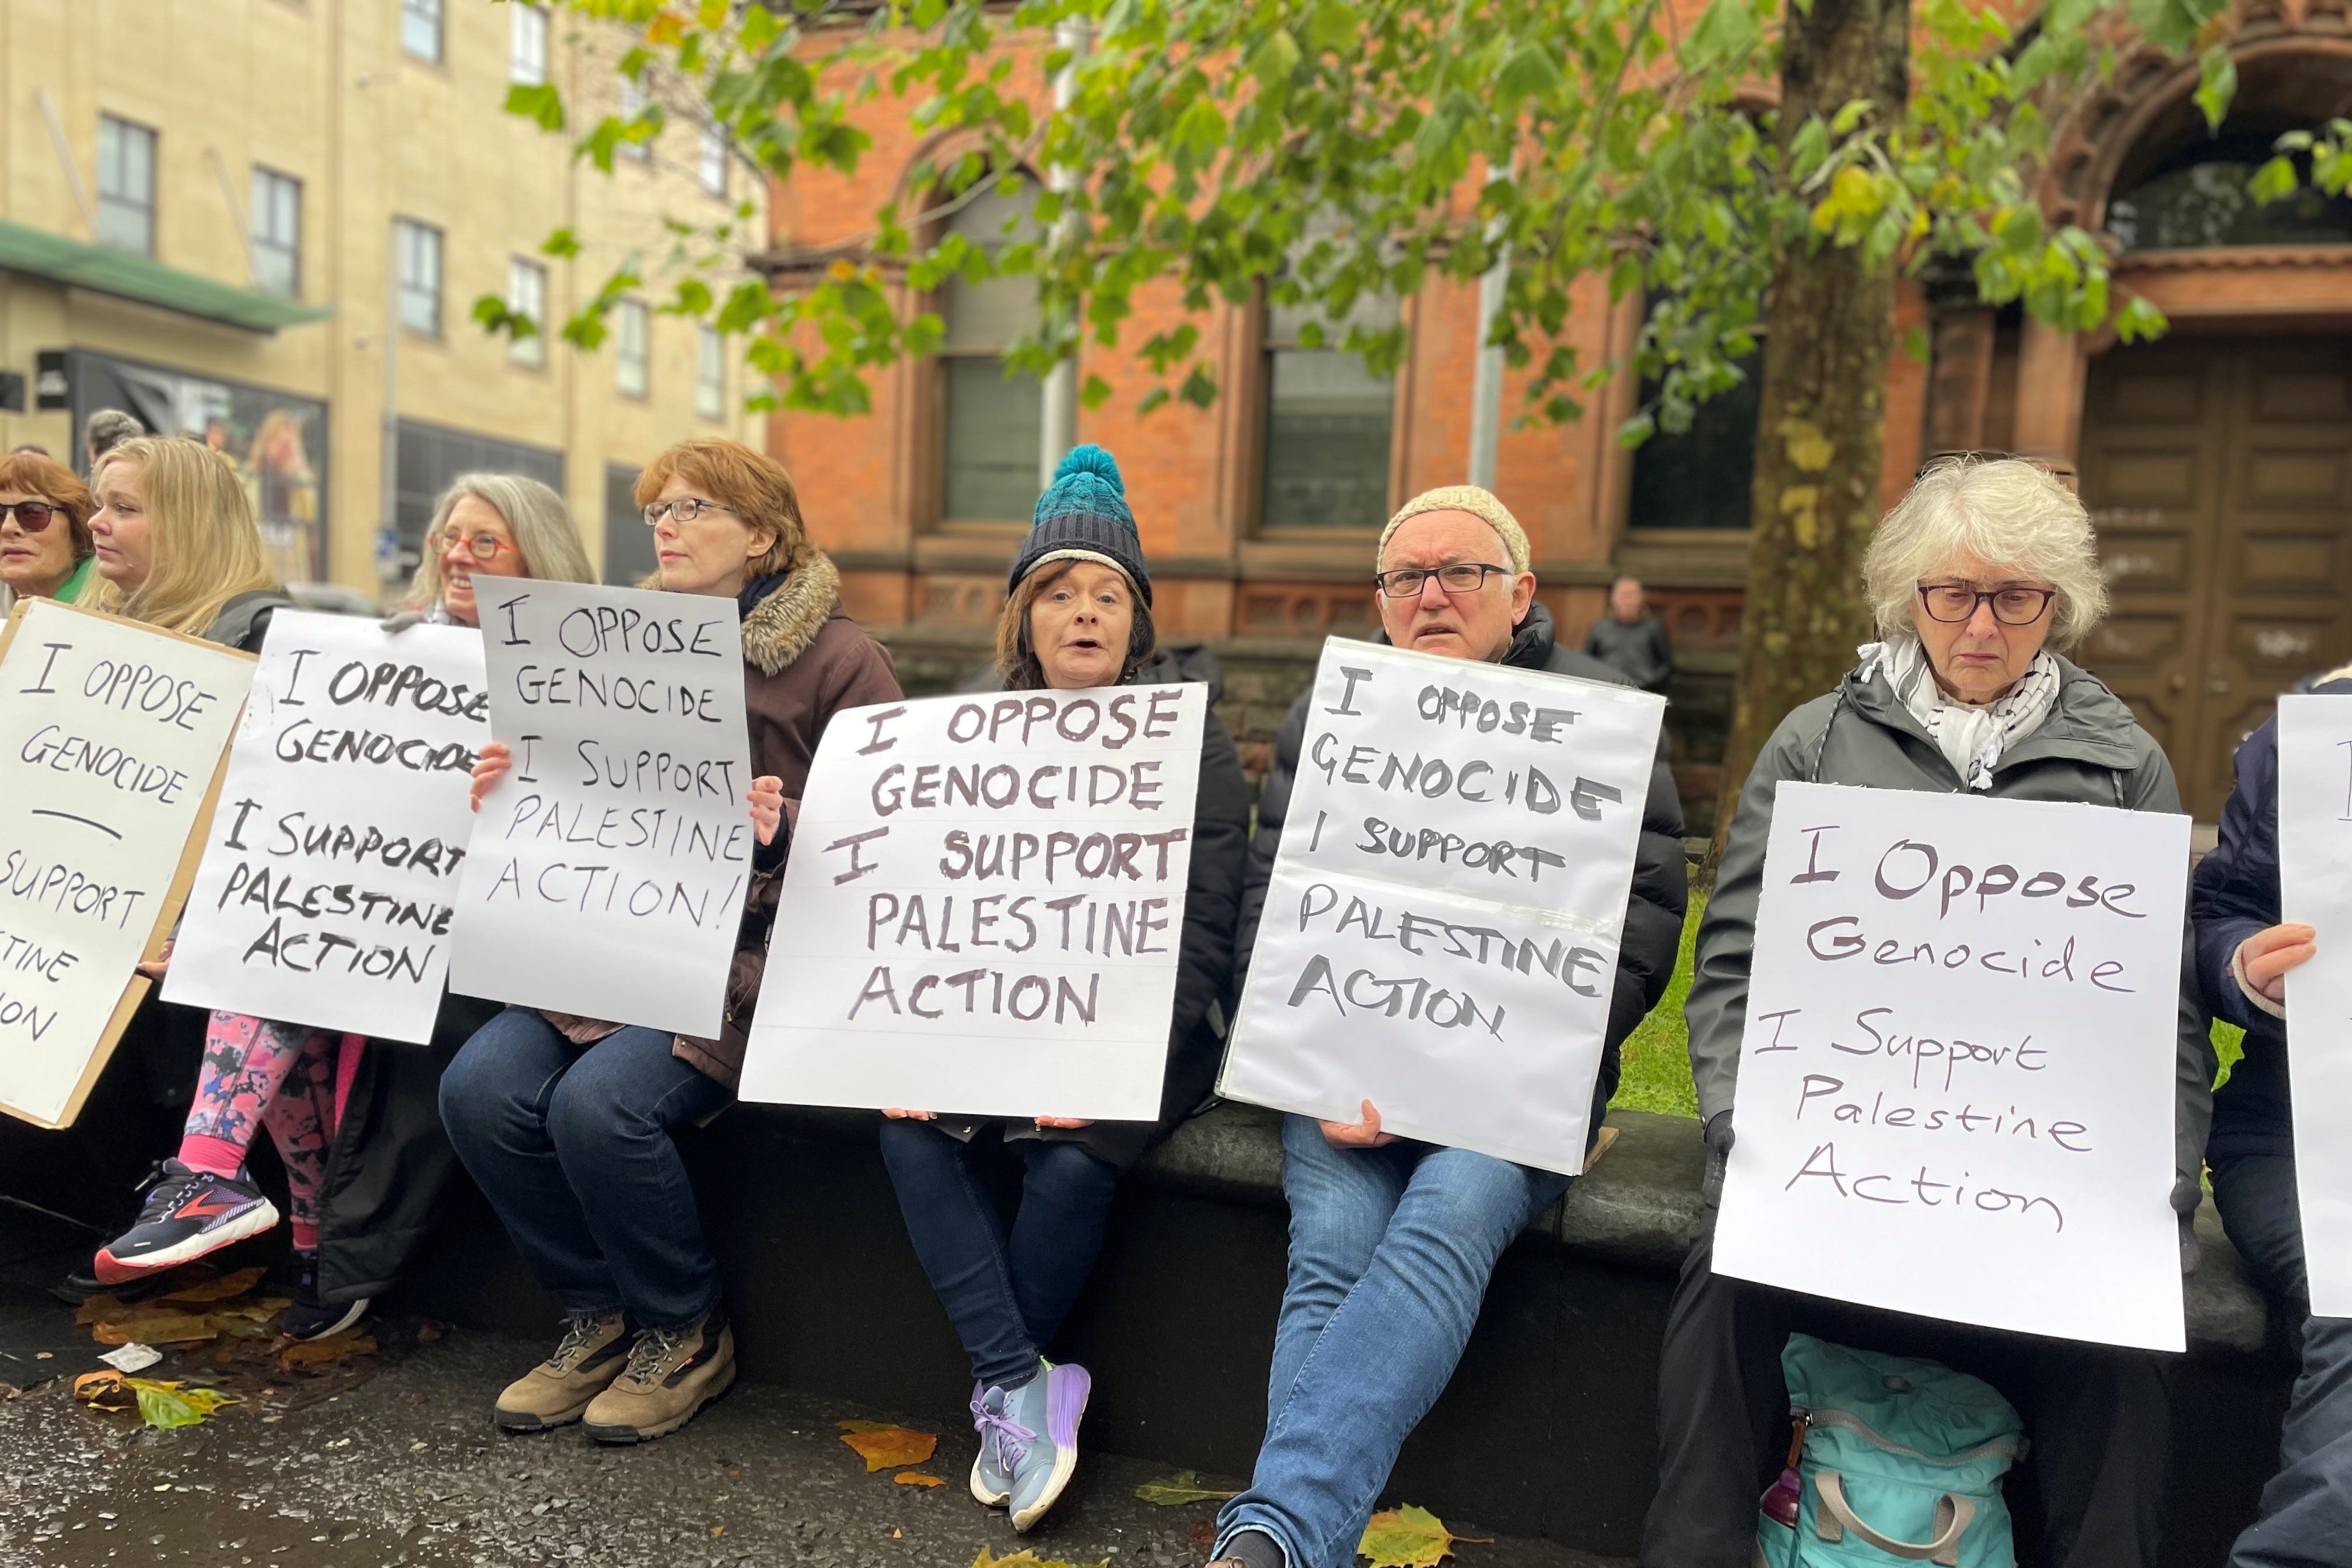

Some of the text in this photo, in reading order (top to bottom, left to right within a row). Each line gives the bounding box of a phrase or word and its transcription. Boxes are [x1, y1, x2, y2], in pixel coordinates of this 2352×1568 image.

[498, 593, 724, 659] I OPPOSE
[19, 642, 218, 732] I OPPOSE
[278, 649, 489, 723] I OPPOSE
[516, 664, 722, 723] GENOCIDE
[855, 688, 1184, 757] I OPPOSE
[1324, 666, 1583, 744] I OPPOSE
[20, 724, 188, 804] GENOCIDE
[517, 734, 735, 807] I SUPPORT
[871, 761, 1166, 817] GENOCIDE
[1311, 732, 1622, 821] GENOCIDE
[223, 797, 466, 878] I SUPPORT
[506, 794, 746, 863] PALESTINE
[822, 825, 1189, 887] I SUPPORT
[1308, 809, 1566, 883] I SUPPORT
[0, 849, 146, 930] SUPPORT
[217, 862, 454, 936] PALESTINE
[487, 856, 743, 928] ACTION!
[1789, 825, 2148, 921] I Oppose
[242, 916, 437, 985] ACTION
[867, 892, 1169, 959] PALESTINE
[1299, 883, 1609, 998] PALESTINE
[1806, 916, 2137, 993] Genocide
[847, 965, 1100, 1028] ACTION
[1287, 954, 1506, 1044] ACTION
[1754, 1007, 2049, 1093] I Support
[1797, 1074, 2093, 1152] Palestine
[1784, 1142, 2063, 1234] Action
